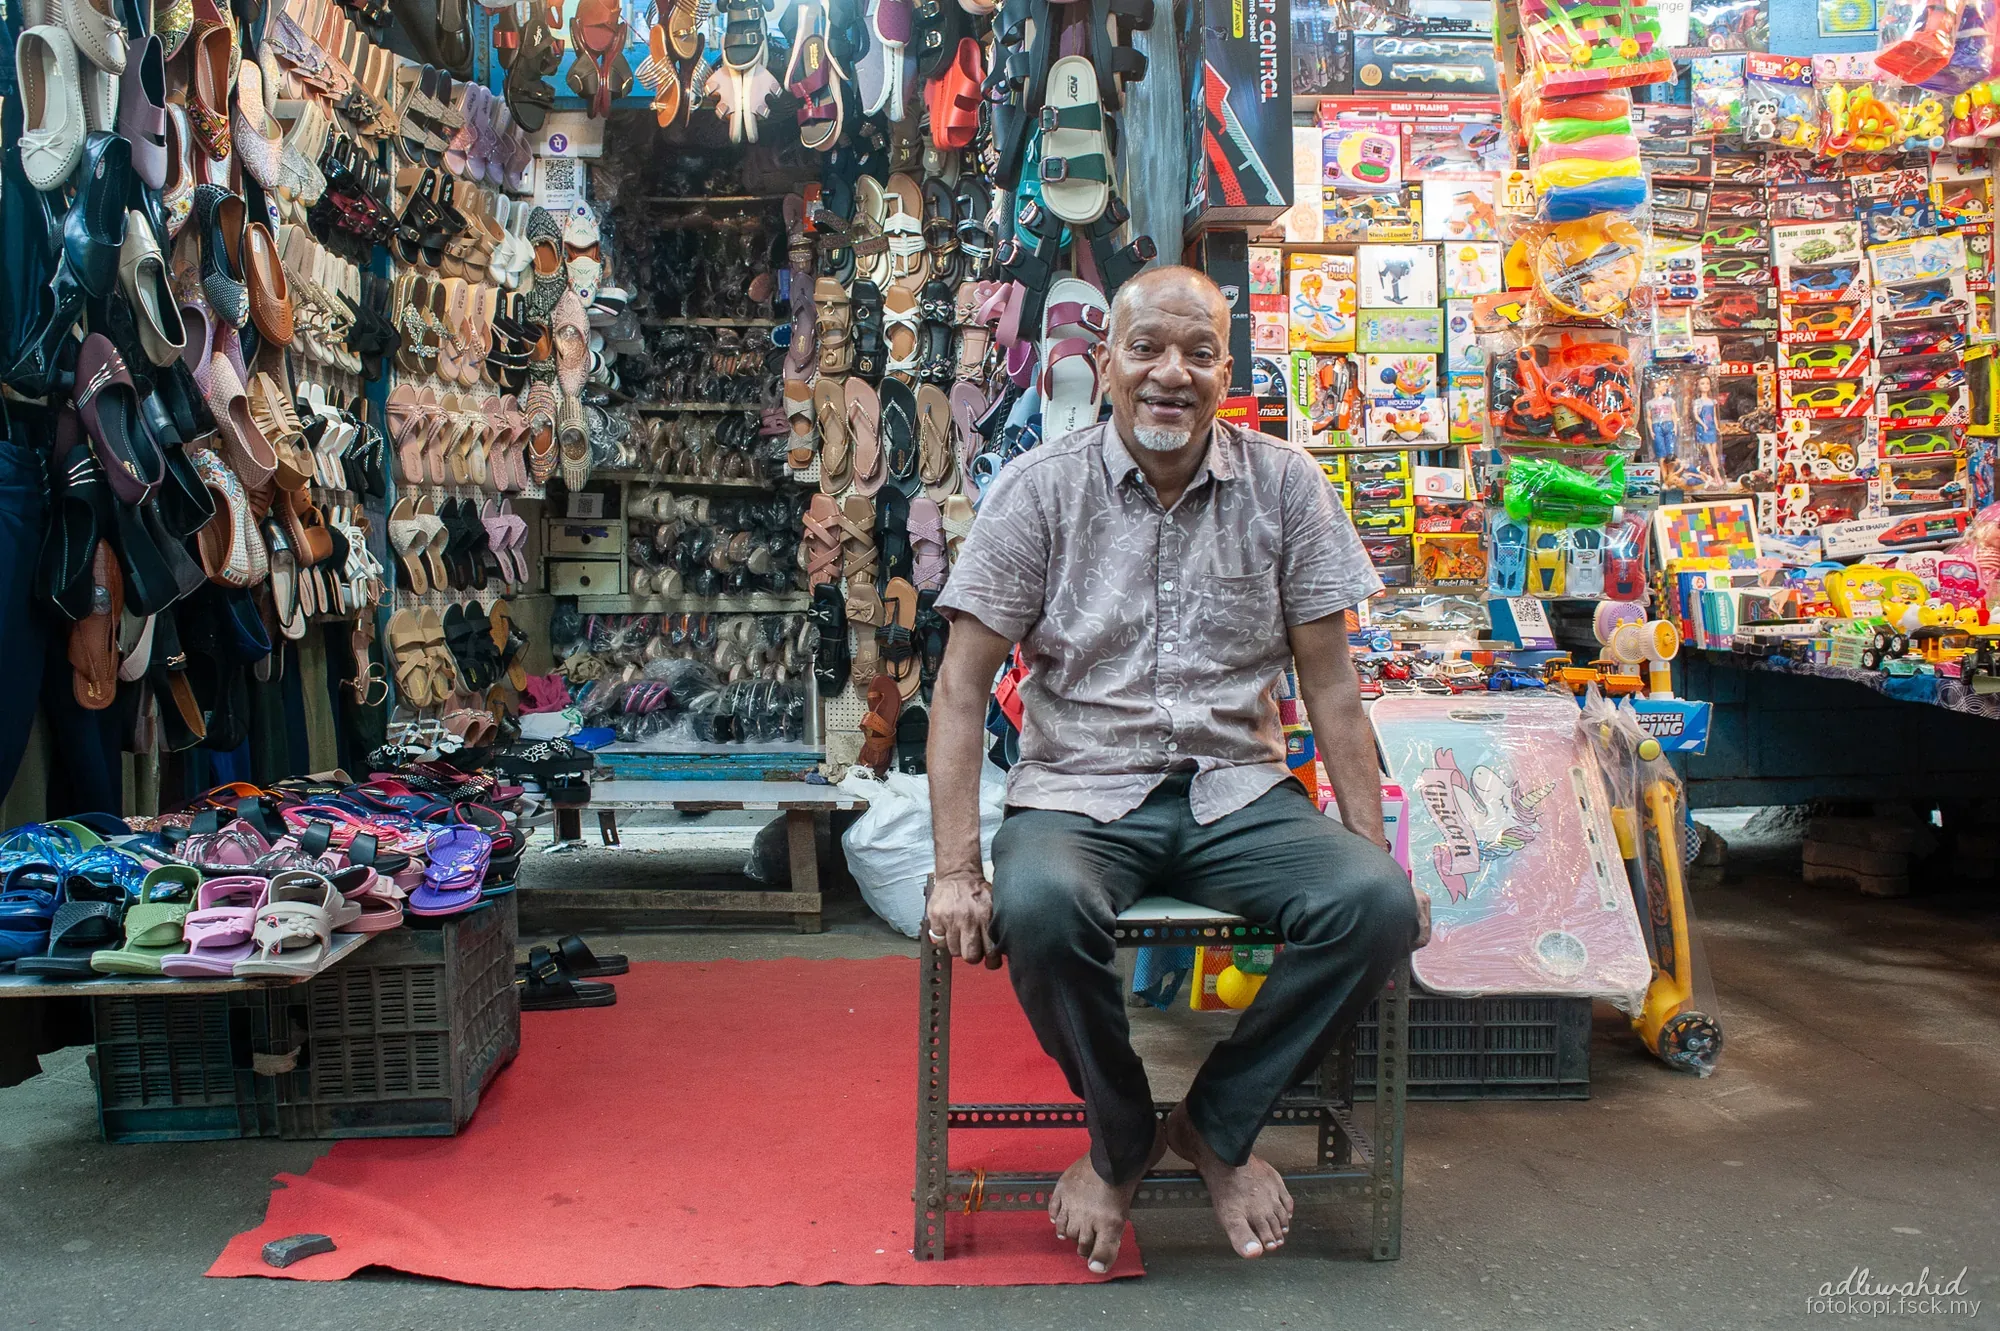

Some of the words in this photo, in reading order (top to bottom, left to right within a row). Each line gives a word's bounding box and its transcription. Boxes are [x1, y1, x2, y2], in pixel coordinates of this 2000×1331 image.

[1248, 13, 1258, 43] Speed
[1338, 31, 1348, 43] EL
[1259, 19, 1279, 104] CONTROL
[1070, 75, 1078, 102] NDY
[1391, 103, 1412, 111] EMU
[1414, 103, 1449, 111] TRAINS
[1778, 230, 1798, 238] TANK
[1800, 228, 1826, 236] ROBOT
[1321, 261, 1354, 273] Small
[1370, 320, 1379, 342] TOM
[1781, 331, 1818, 344] SPRAY
[1731, 364, 1749, 374] 2.0
[1779, 368, 1816, 380] SPRAY
[1457, 377, 1483, 385] Peacock
[1388, 399, 1422, 407] INDUCTION
[1215, 407, 1247, 418] OYSMITH
[1258, 408, 1285, 416] -max
[1781, 408, 1819, 419] SPRAY
[1843, 525, 1866, 534] VANDE
[1865, 521, 1890, 532] BHARAT
[1398, 587, 1427, 595] ARMY
[1718, 595, 1727, 617] PANEL
[1719, 617, 1729, 631] LCD
[1634, 712, 1682, 722] ORCYCLE
[1639, 721, 1684, 736] CING
[1317, 789, 1332, 798] le
[1424, 779, 1472, 858] Unicorn
